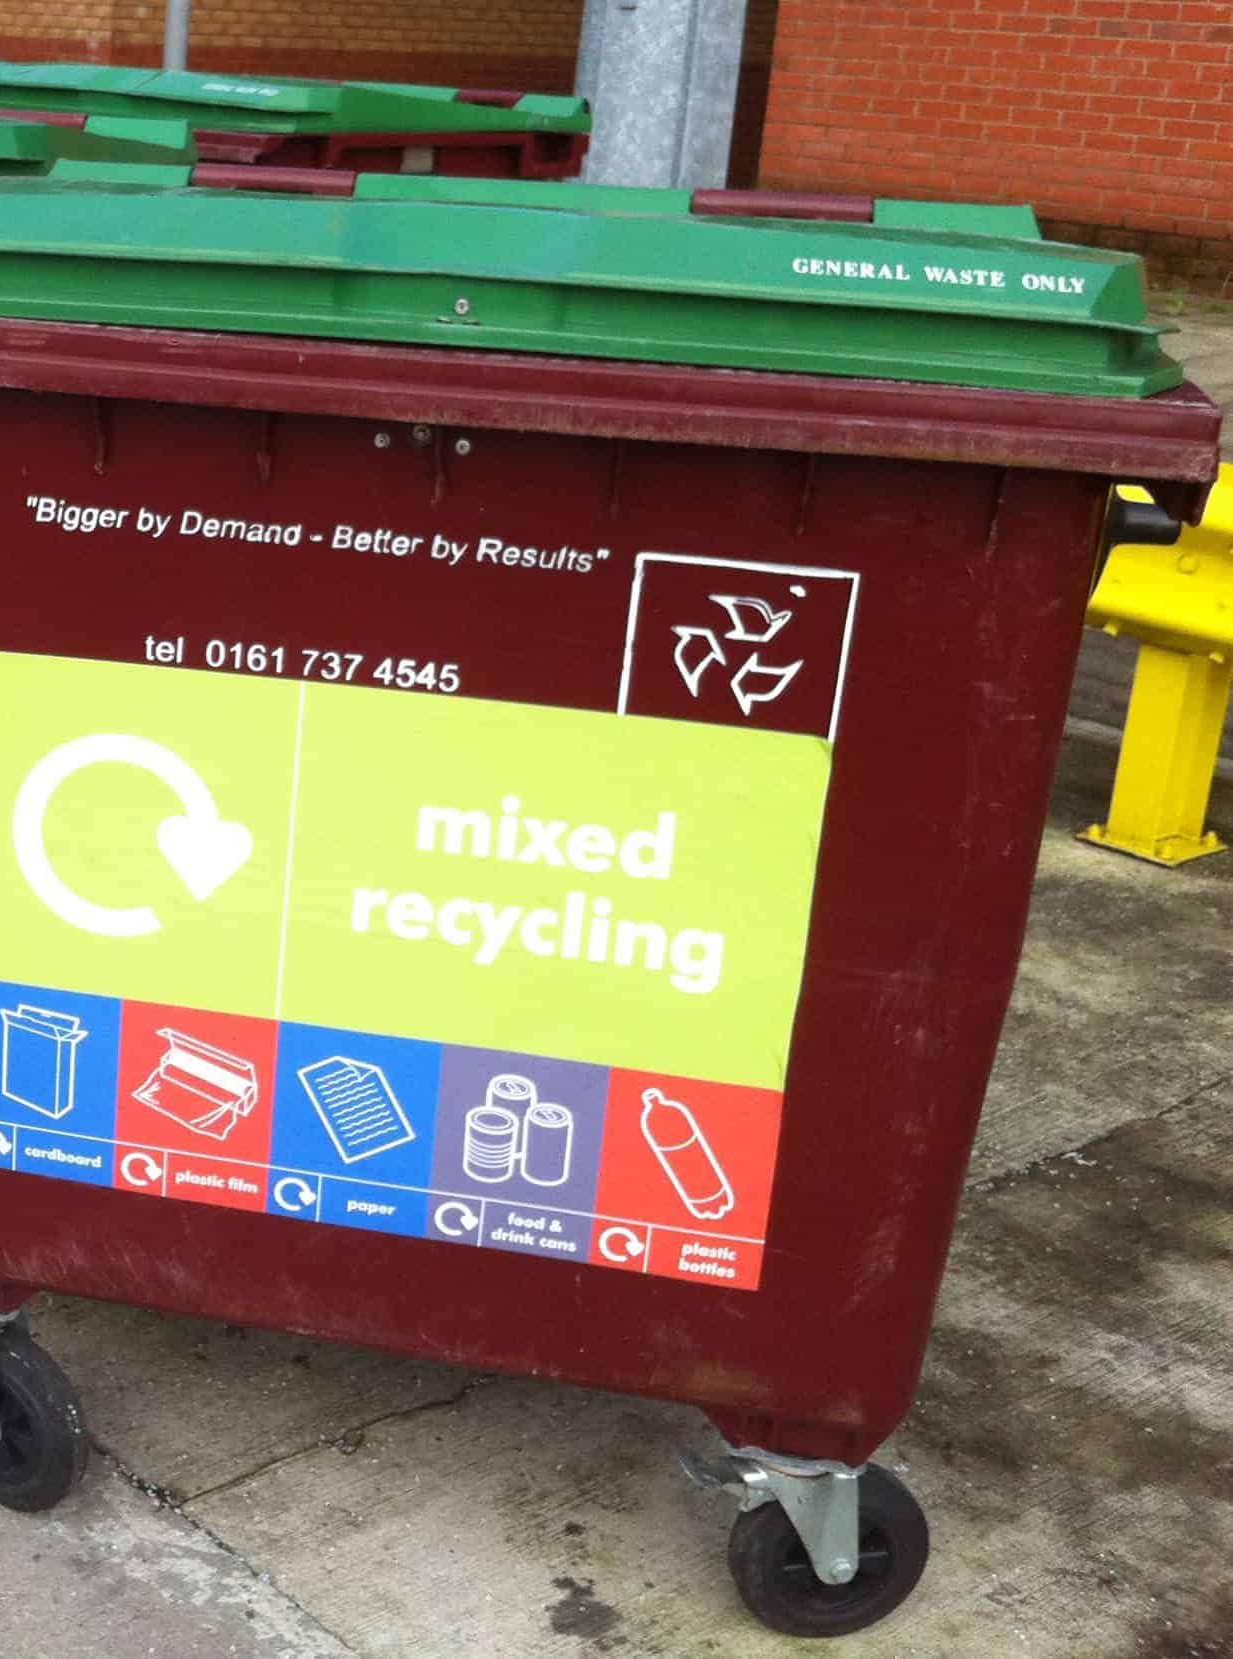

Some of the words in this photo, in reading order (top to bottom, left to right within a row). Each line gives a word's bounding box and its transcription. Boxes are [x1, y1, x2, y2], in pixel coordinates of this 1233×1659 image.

[791, 257, 911, 281] GENERAL
[923, 266, 1007, 288] WASTE
[1022, 273, 1086, 294] ONLY
[25, 495, 129, 533] "Bigger
[137, 507, 170, 538] by
[180, 511, 302, 547] Demand
[332, 525, 424, 558] Better
[431, 534, 467, 565] by
[476, 538, 611, 573] Results"
[144, 633, 184, 664] tel
[205, 638, 286, 674] 0161
[301, 649, 363, 681] 737
[373, 657, 460, 693] 4545
[414, 793, 678, 880] mixed
[349, 886, 726, 995] recycling
[24, 1145, 102, 1169] cardboard
[174, 1170, 225, 1190] plastic
[228, 1175, 258, 1194] film
[346, 1198, 397, 1217] paper
[507, 1212, 545, 1231] food
[549, 1219, 563, 1233] &
[490, 1228, 535, 1248] drink
[539, 1237, 577, 1253] cans
[681, 1242, 738, 1262] plastic
[678, 1258, 736, 1279] bottles
